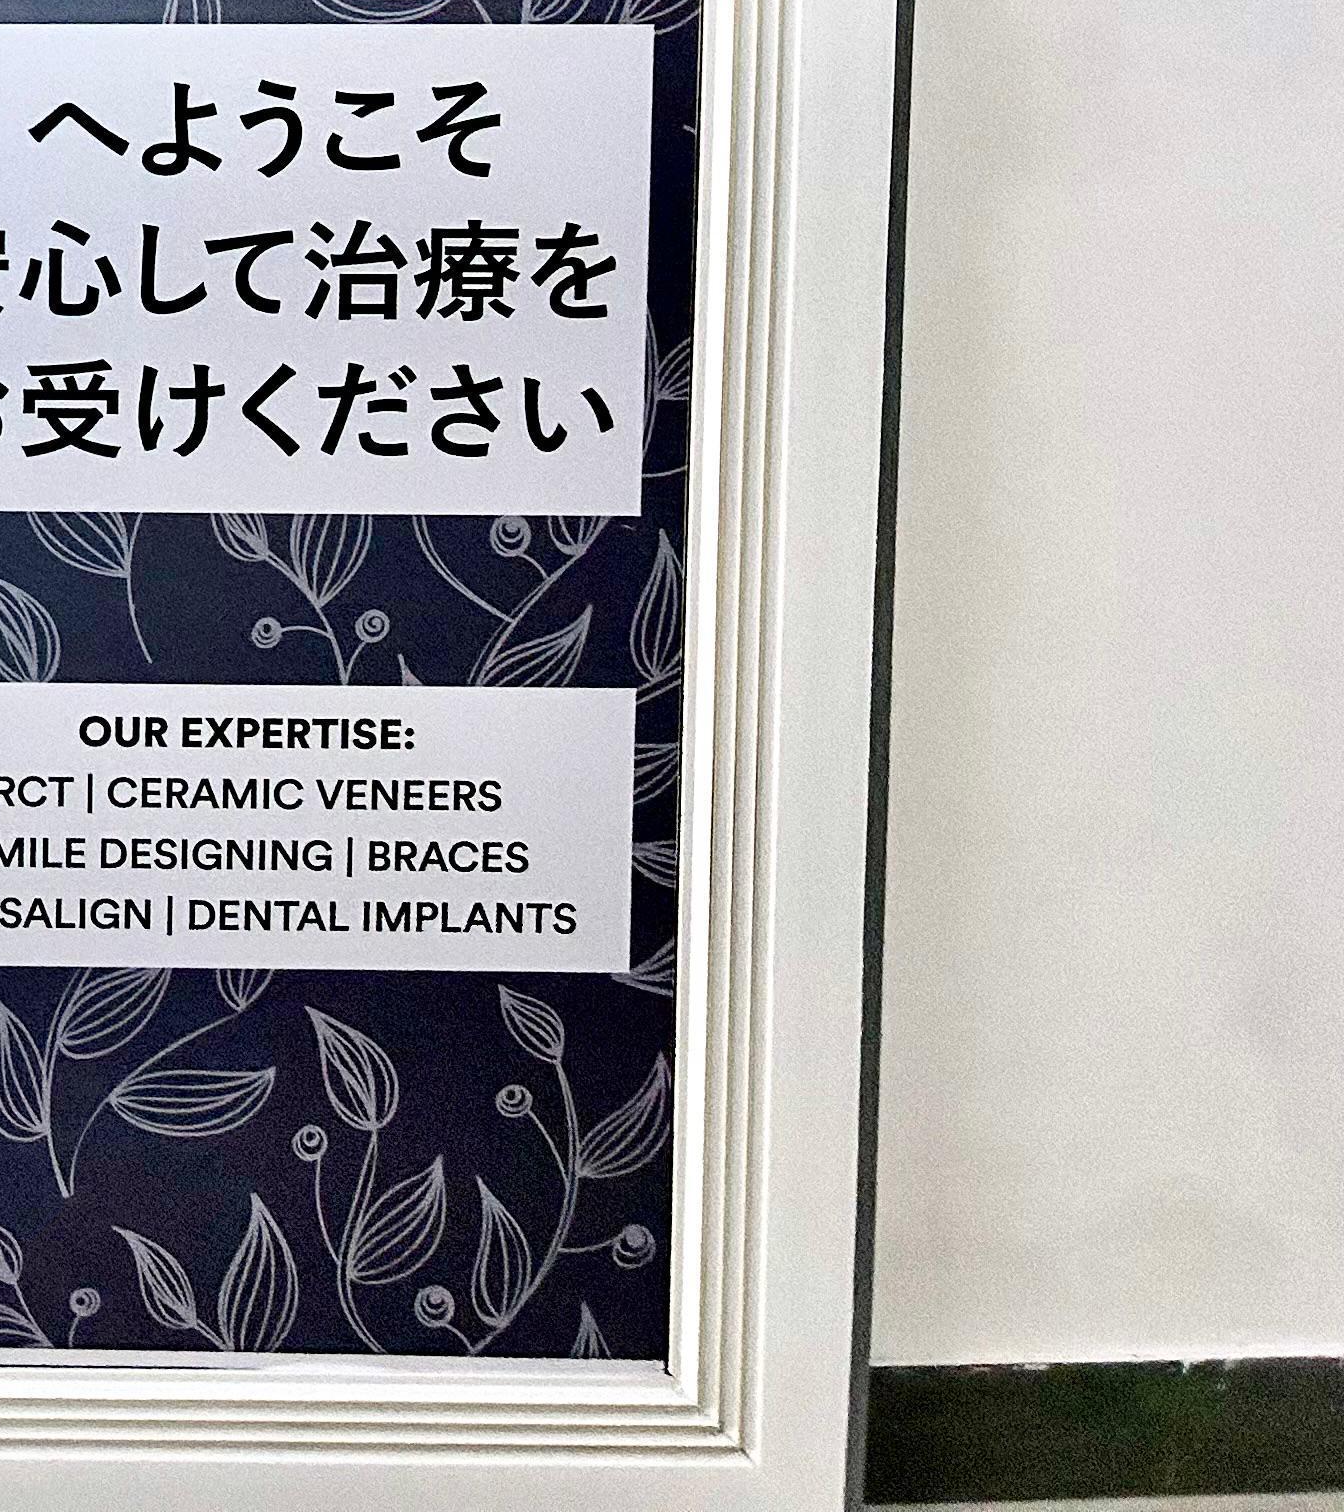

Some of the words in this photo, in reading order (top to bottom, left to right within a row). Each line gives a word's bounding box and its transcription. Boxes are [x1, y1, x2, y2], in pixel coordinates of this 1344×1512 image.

[26, 78, 502, 179] へようこそ
[77, 714, 170, 749] OUR
[180, 715, 416, 751] EXPERTISE:
[106, 775, 305, 812] CERAMIC
[314, 778, 503, 814] VENEERS
[99, 836, 334, 873] DESIGNING
[367, 839, 531, 875] BRACES
[187, 898, 351, 933] DENTAL
[361, 899, 578, 936] IMPLANTS
